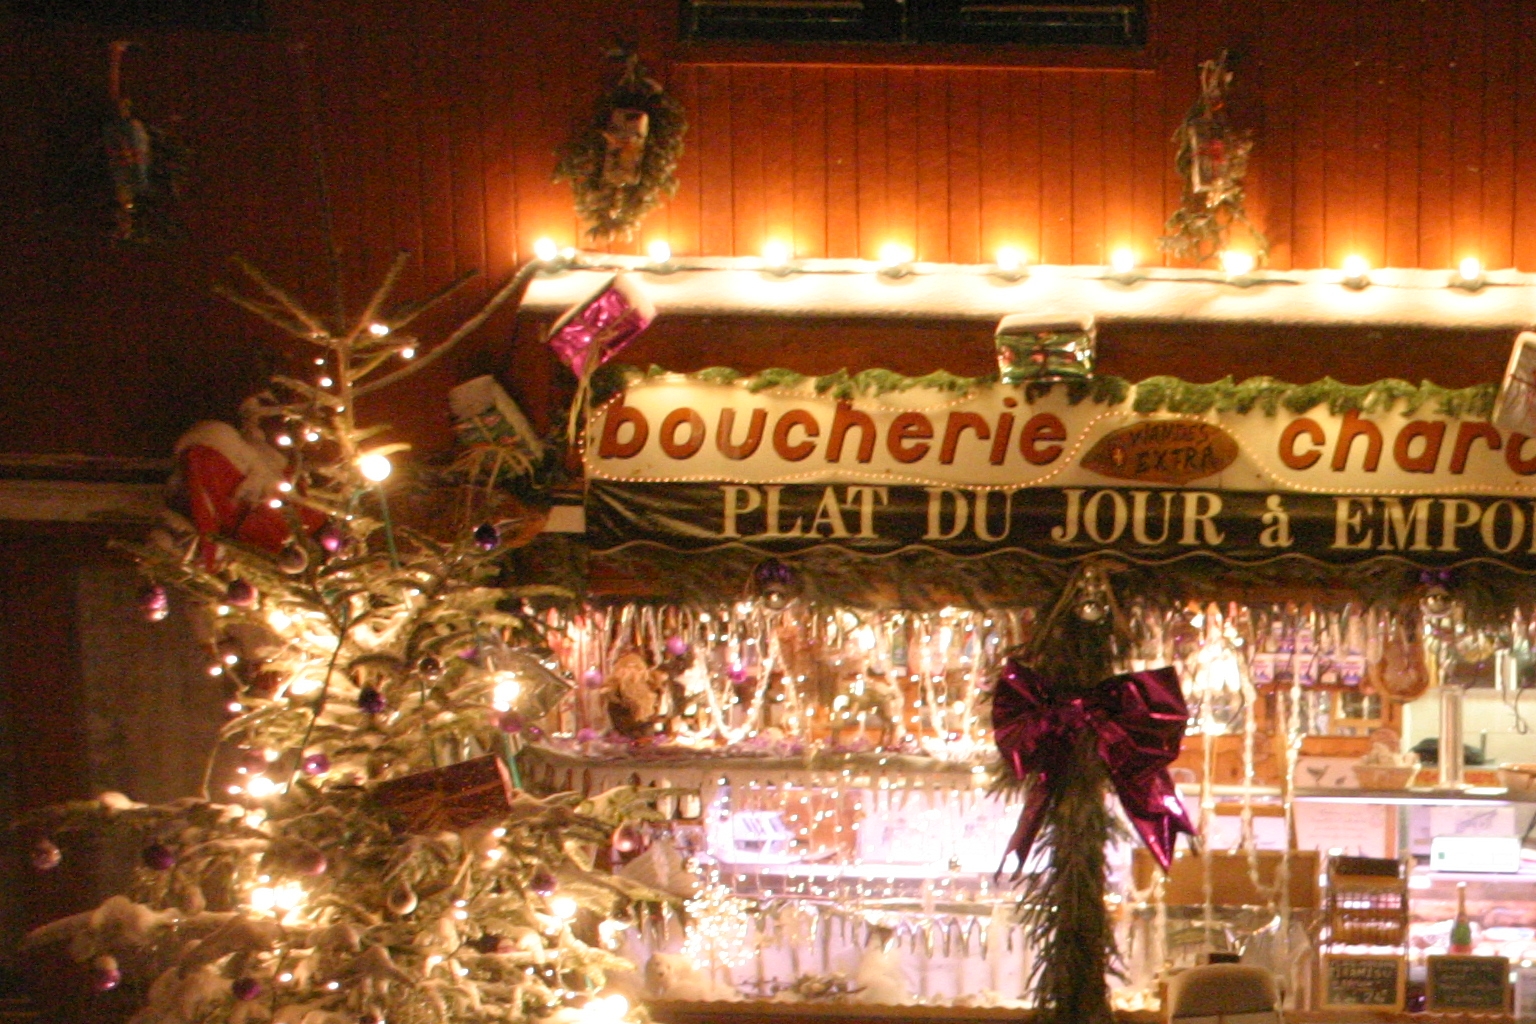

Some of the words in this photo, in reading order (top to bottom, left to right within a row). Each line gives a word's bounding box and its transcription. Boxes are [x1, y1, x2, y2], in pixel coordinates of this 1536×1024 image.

[600, 398, 1068, 466] boucherie
[1135, 445, 1217, 474] EXTRA
[719, 486, 889, 541] PLAT
[922, 486, 1015, 542] DU
[1051, 488, 1226, 548] JOUR
[1260, 494, 1293, 549] à
